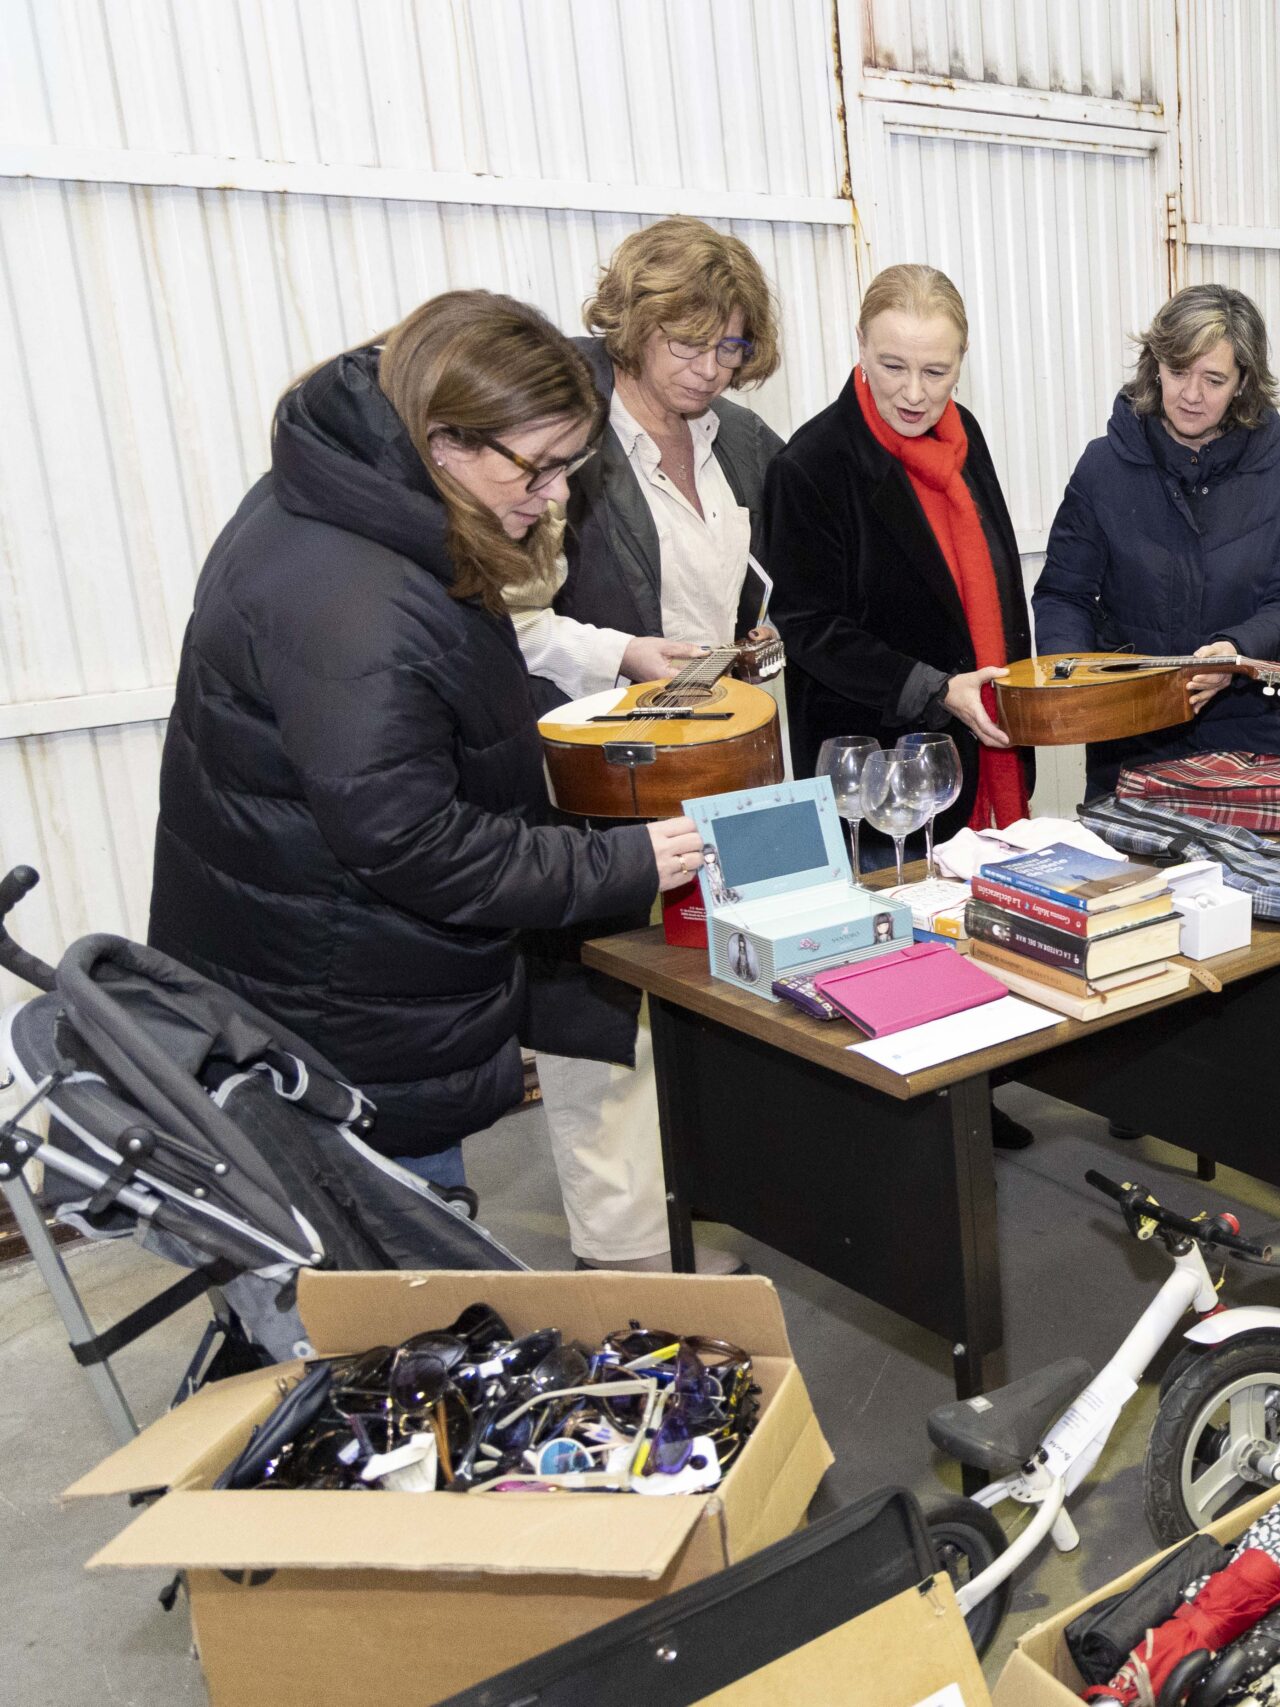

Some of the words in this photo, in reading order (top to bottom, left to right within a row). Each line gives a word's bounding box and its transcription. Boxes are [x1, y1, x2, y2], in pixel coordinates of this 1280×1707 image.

[977, 885, 1012, 905] declaración
[1011, 897, 1022, 909] La
[1027, 937, 1037, 947] DEL
[1037, 942, 1063, 957] CATEDRAL
